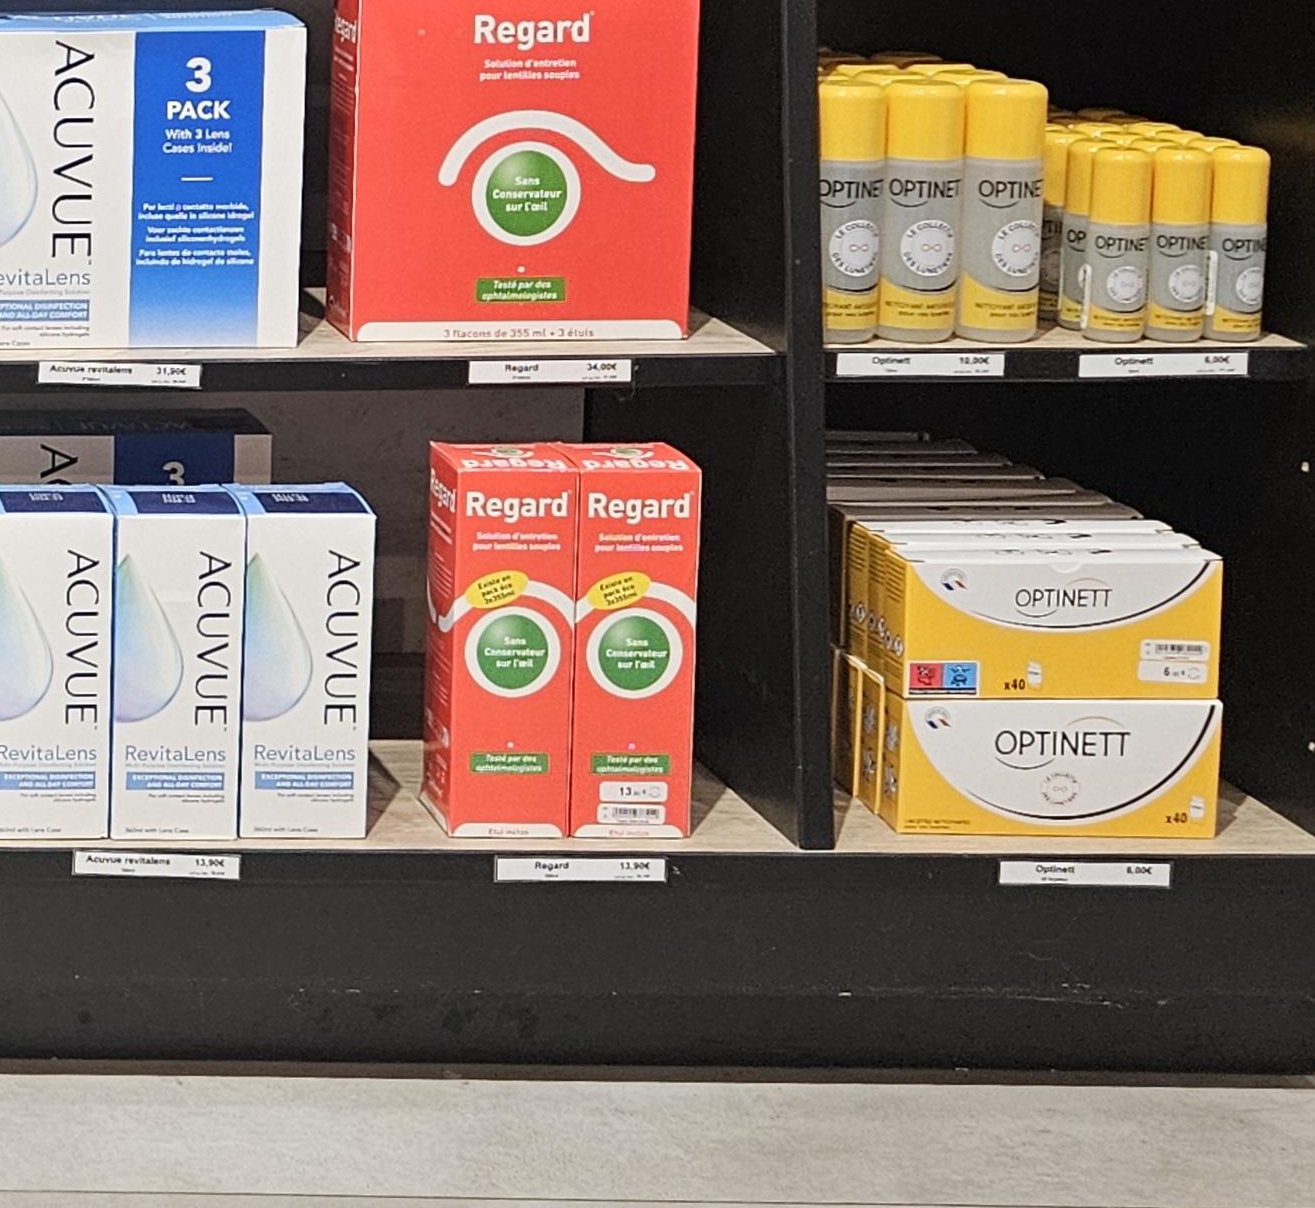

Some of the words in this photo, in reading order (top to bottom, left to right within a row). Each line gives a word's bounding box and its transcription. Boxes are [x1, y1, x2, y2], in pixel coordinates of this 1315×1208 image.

[474, 14, 591, 50] Regard
[52, 41, 95, 258] ACUVUE
[466, 491, 568, 523] Regard
[1015, 588, 1113, 608] OPTINETT
[65, 549, 100, 726] ACUVUE
[1004, 679, 1025, 691] x40
[995, 730, 1131, 757] OPTINETT
[1165, 813, 1188, 825] x40
